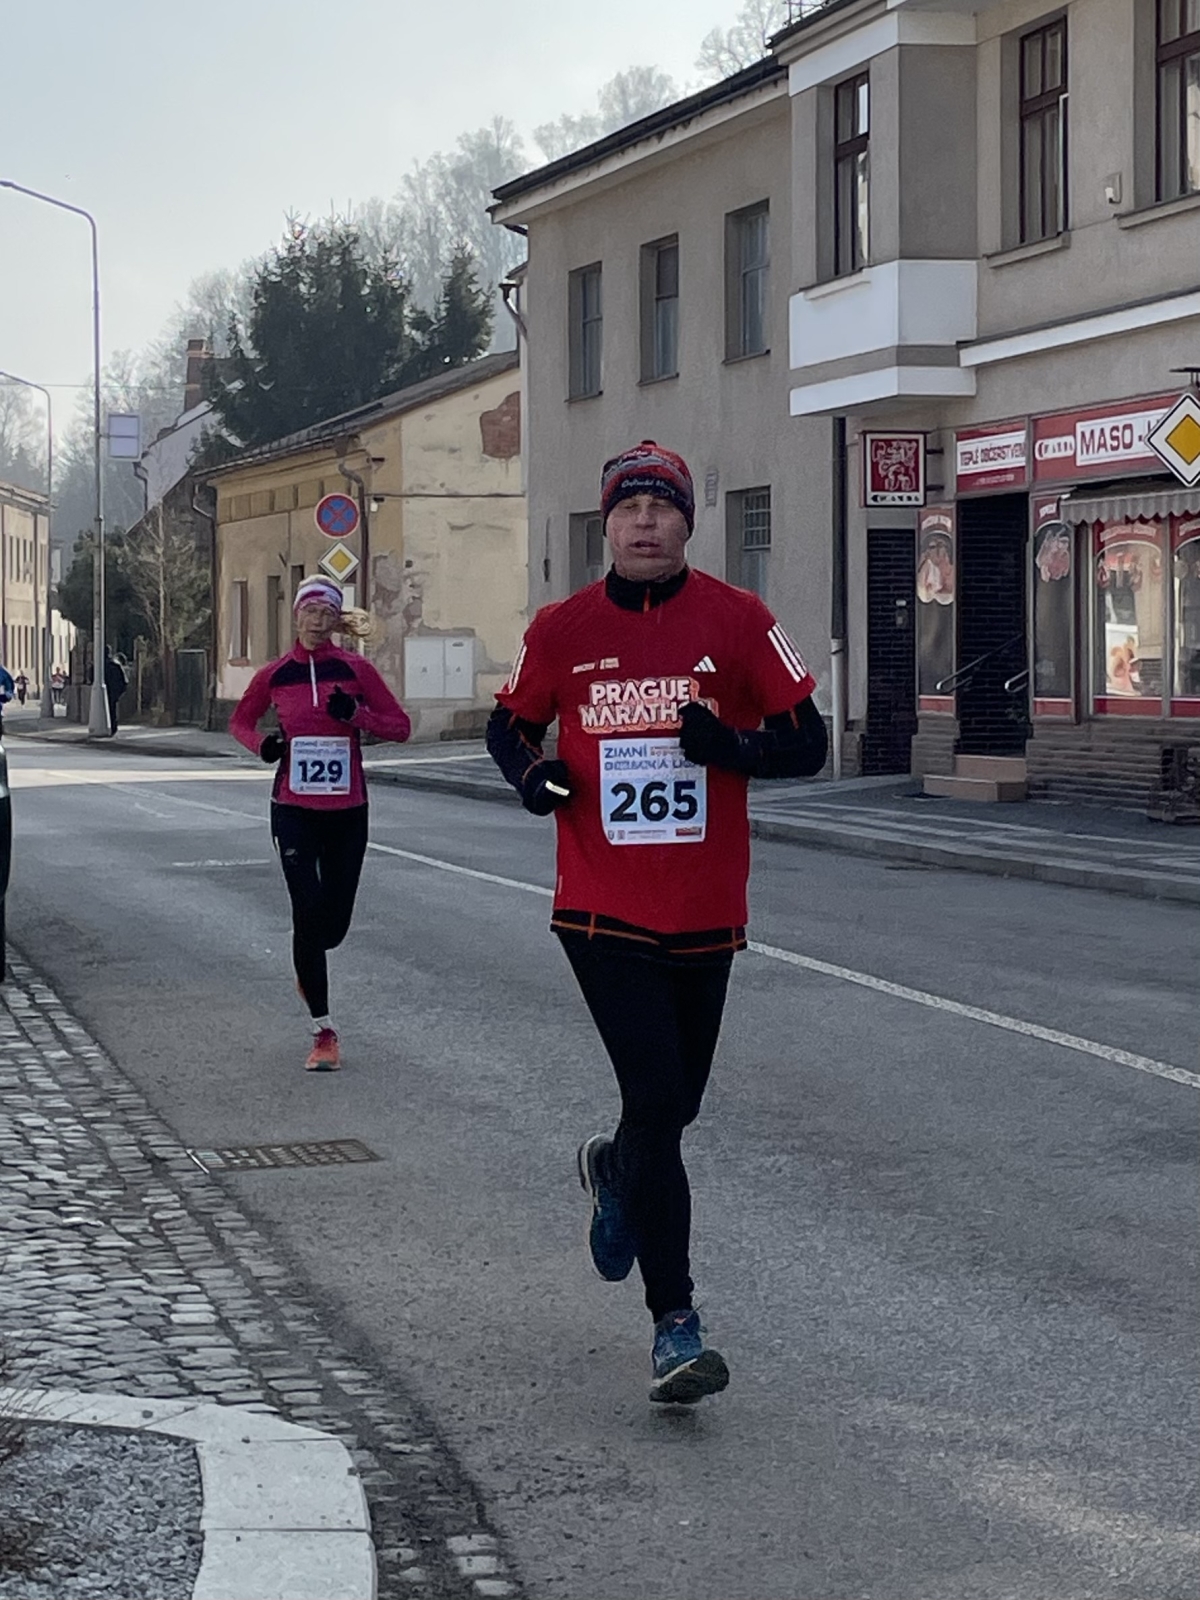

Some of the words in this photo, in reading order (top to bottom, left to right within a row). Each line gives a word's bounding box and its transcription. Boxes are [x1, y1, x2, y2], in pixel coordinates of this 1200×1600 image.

[1080, 423, 1133, 457] MASO
[591, 679, 690, 705] PRAGUE
[604, 743, 647, 759] ZIMNÍ
[298, 760, 343, 783] 129
[610, 781, 698, 822] 265
